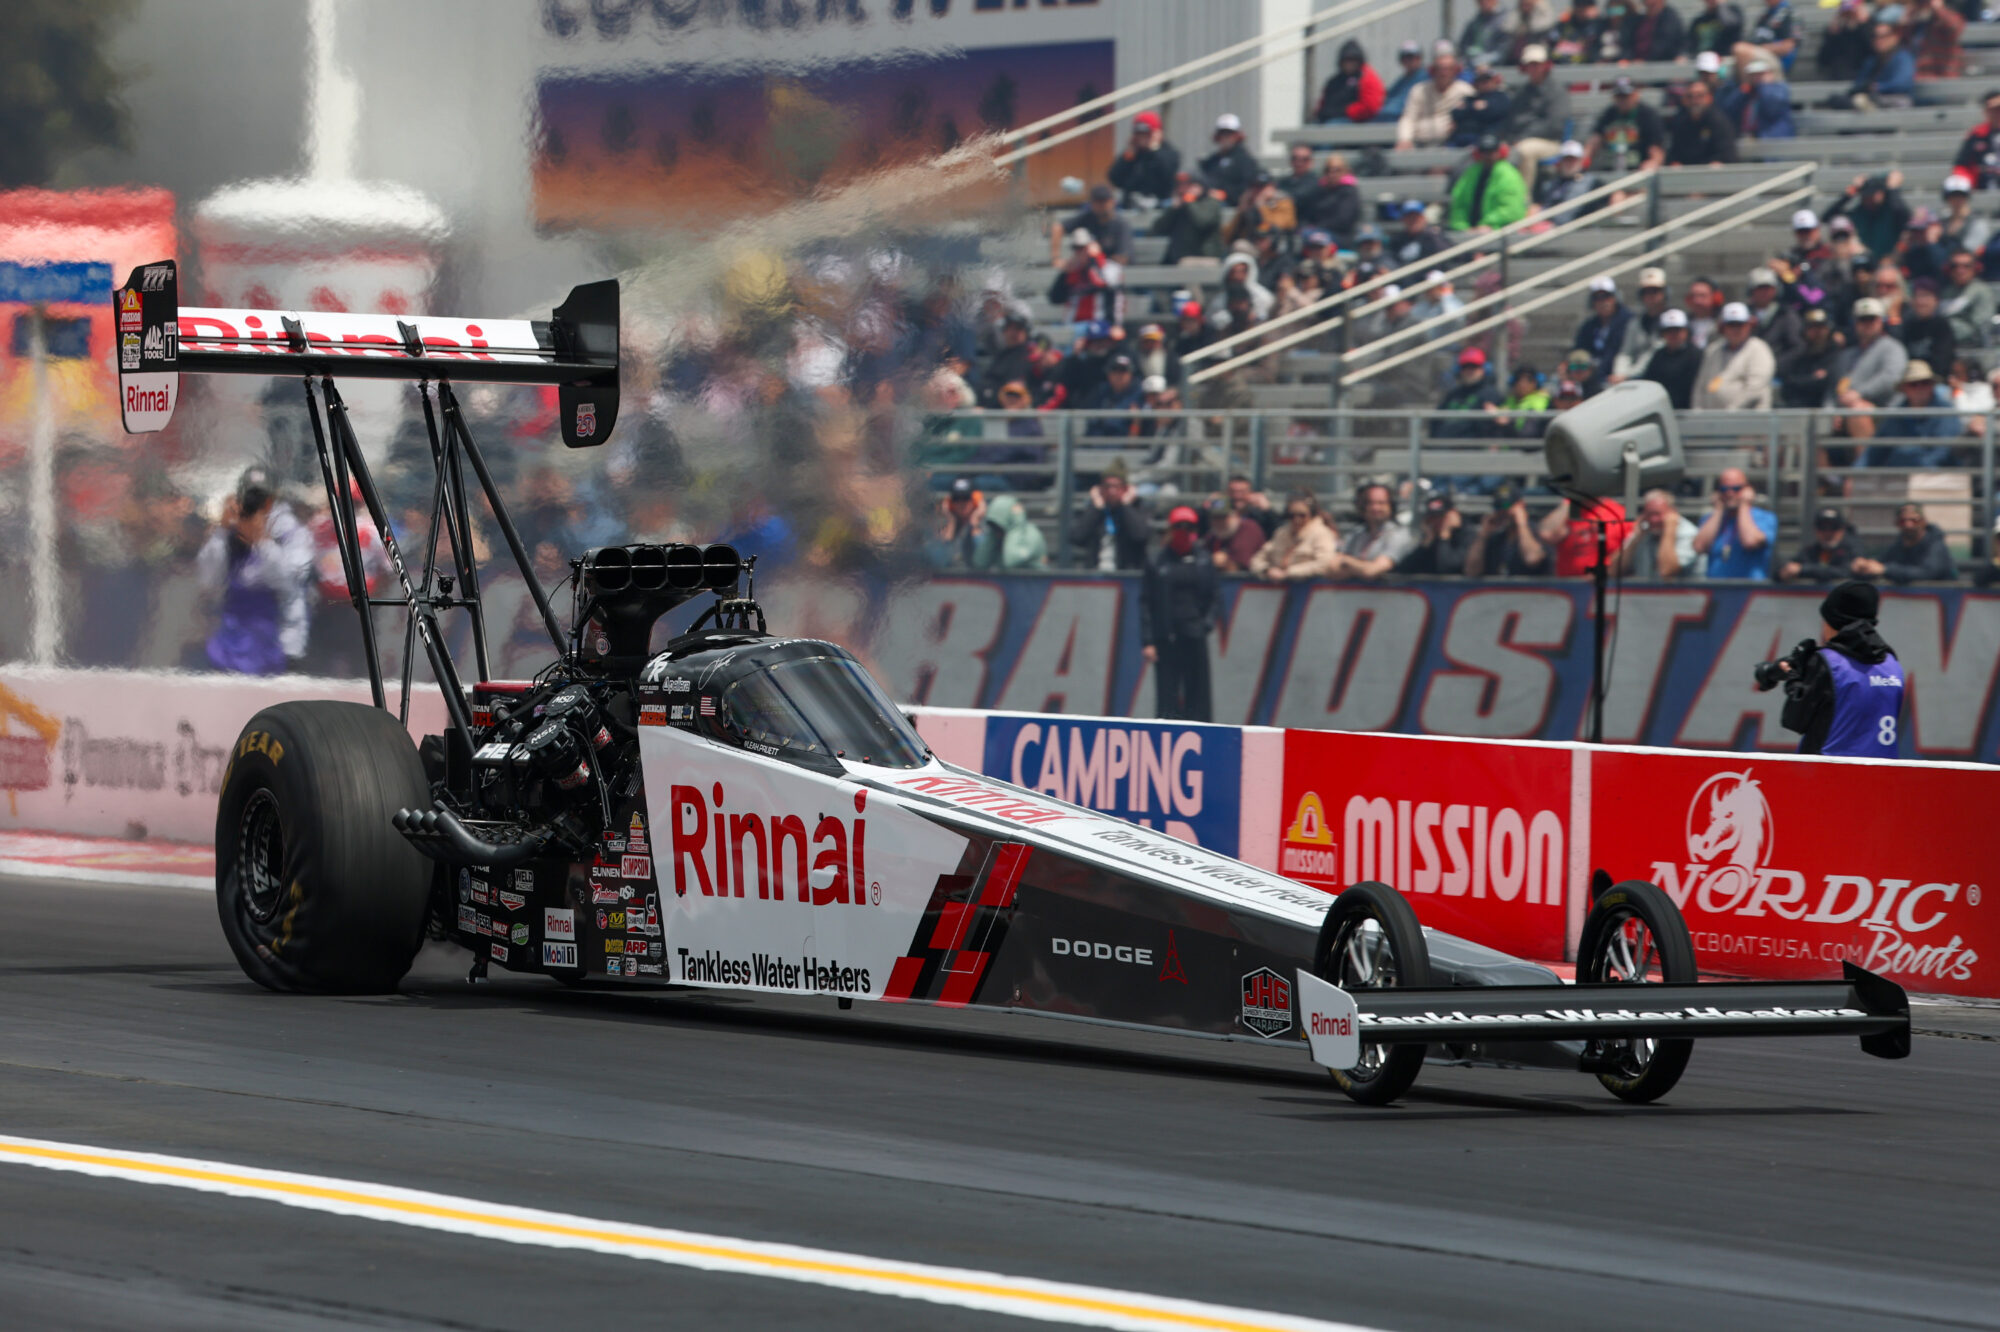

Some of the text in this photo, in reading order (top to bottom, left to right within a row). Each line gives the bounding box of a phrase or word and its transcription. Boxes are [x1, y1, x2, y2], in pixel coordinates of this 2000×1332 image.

[142, 266, 168, 291] 777
[144, 325, 164, 350] MAC
[144, 351, 164, 359] TOOLS
[127, 384, 169, 412] Rinnai
[876, 578, 2000, 756] RANDSTAN
[1869, 675, 1902, 687] Media
[552, 695, 576, 703] MSD
[640, 704, 667, 713] AMERICAN
[531, 725, 557, 744] MSD
[1878, 715, 1896, 746] 8
[1011, 722, 1203, 817] CAMPING
[894, 776, 1101, 824] Rinnai
[671, 781, 867, 906] Rinnai
[1344, 795, 1563, 906] MISSION
[515, 869, 533, 882] WELD
[592, 867, 620, 877] SUNNEN
[623, 857, 649, 877] SIMPSON
[1651, 861, 1959, 932] NORDIC
[547, 915, 573, 932] Rinnai
[544, 945, 574, 963] Mobil 1
[626, 941, 647, 953] ARP
[1052, 938, 1153, 965] DODGE
[1863, 925, 1978, 980] Boats
[678, 948, 750, 984] Tankless
[752, 953, 800, 989] Water
[803, 957, 871, 993] Heaters
[1244, 974, 1289, 1011] JHG
[1250, 1018, 1283, 1031] GARAGE
[1311, 1012, 1351, 1036] Rinnai
[1358, 1006, 1868, 1026] Tankless Water Heaters
